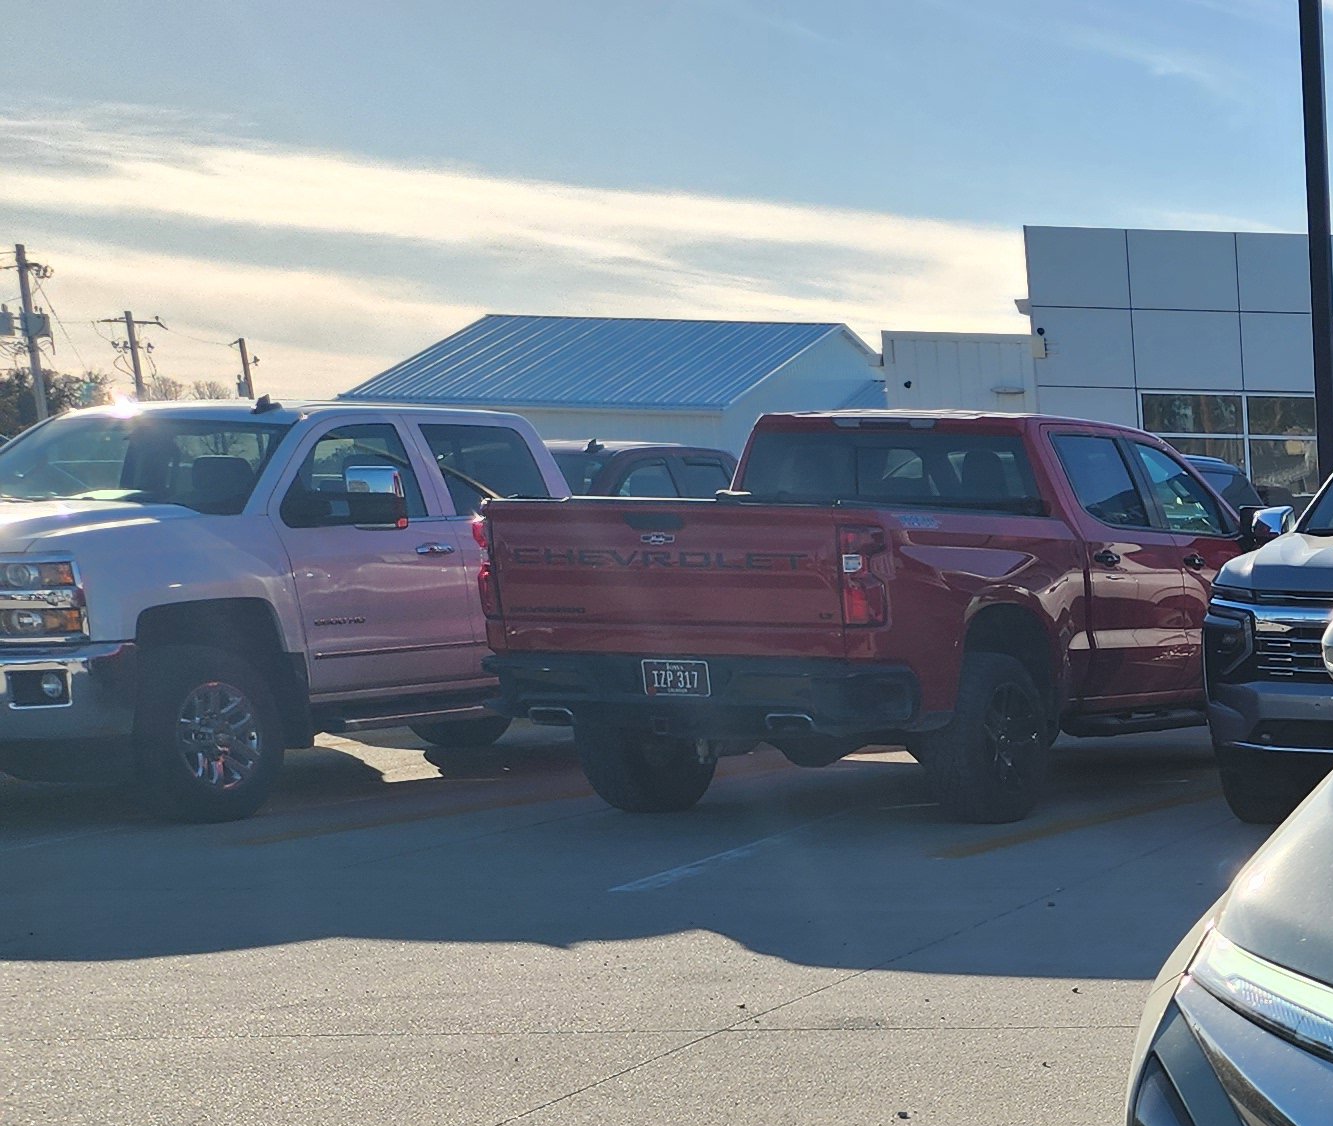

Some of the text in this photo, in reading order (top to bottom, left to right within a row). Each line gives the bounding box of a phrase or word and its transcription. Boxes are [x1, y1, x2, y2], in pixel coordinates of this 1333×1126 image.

[512, 547, 809, 570] CHEVROLET
[652, 670, 698, 688] IZP 317
